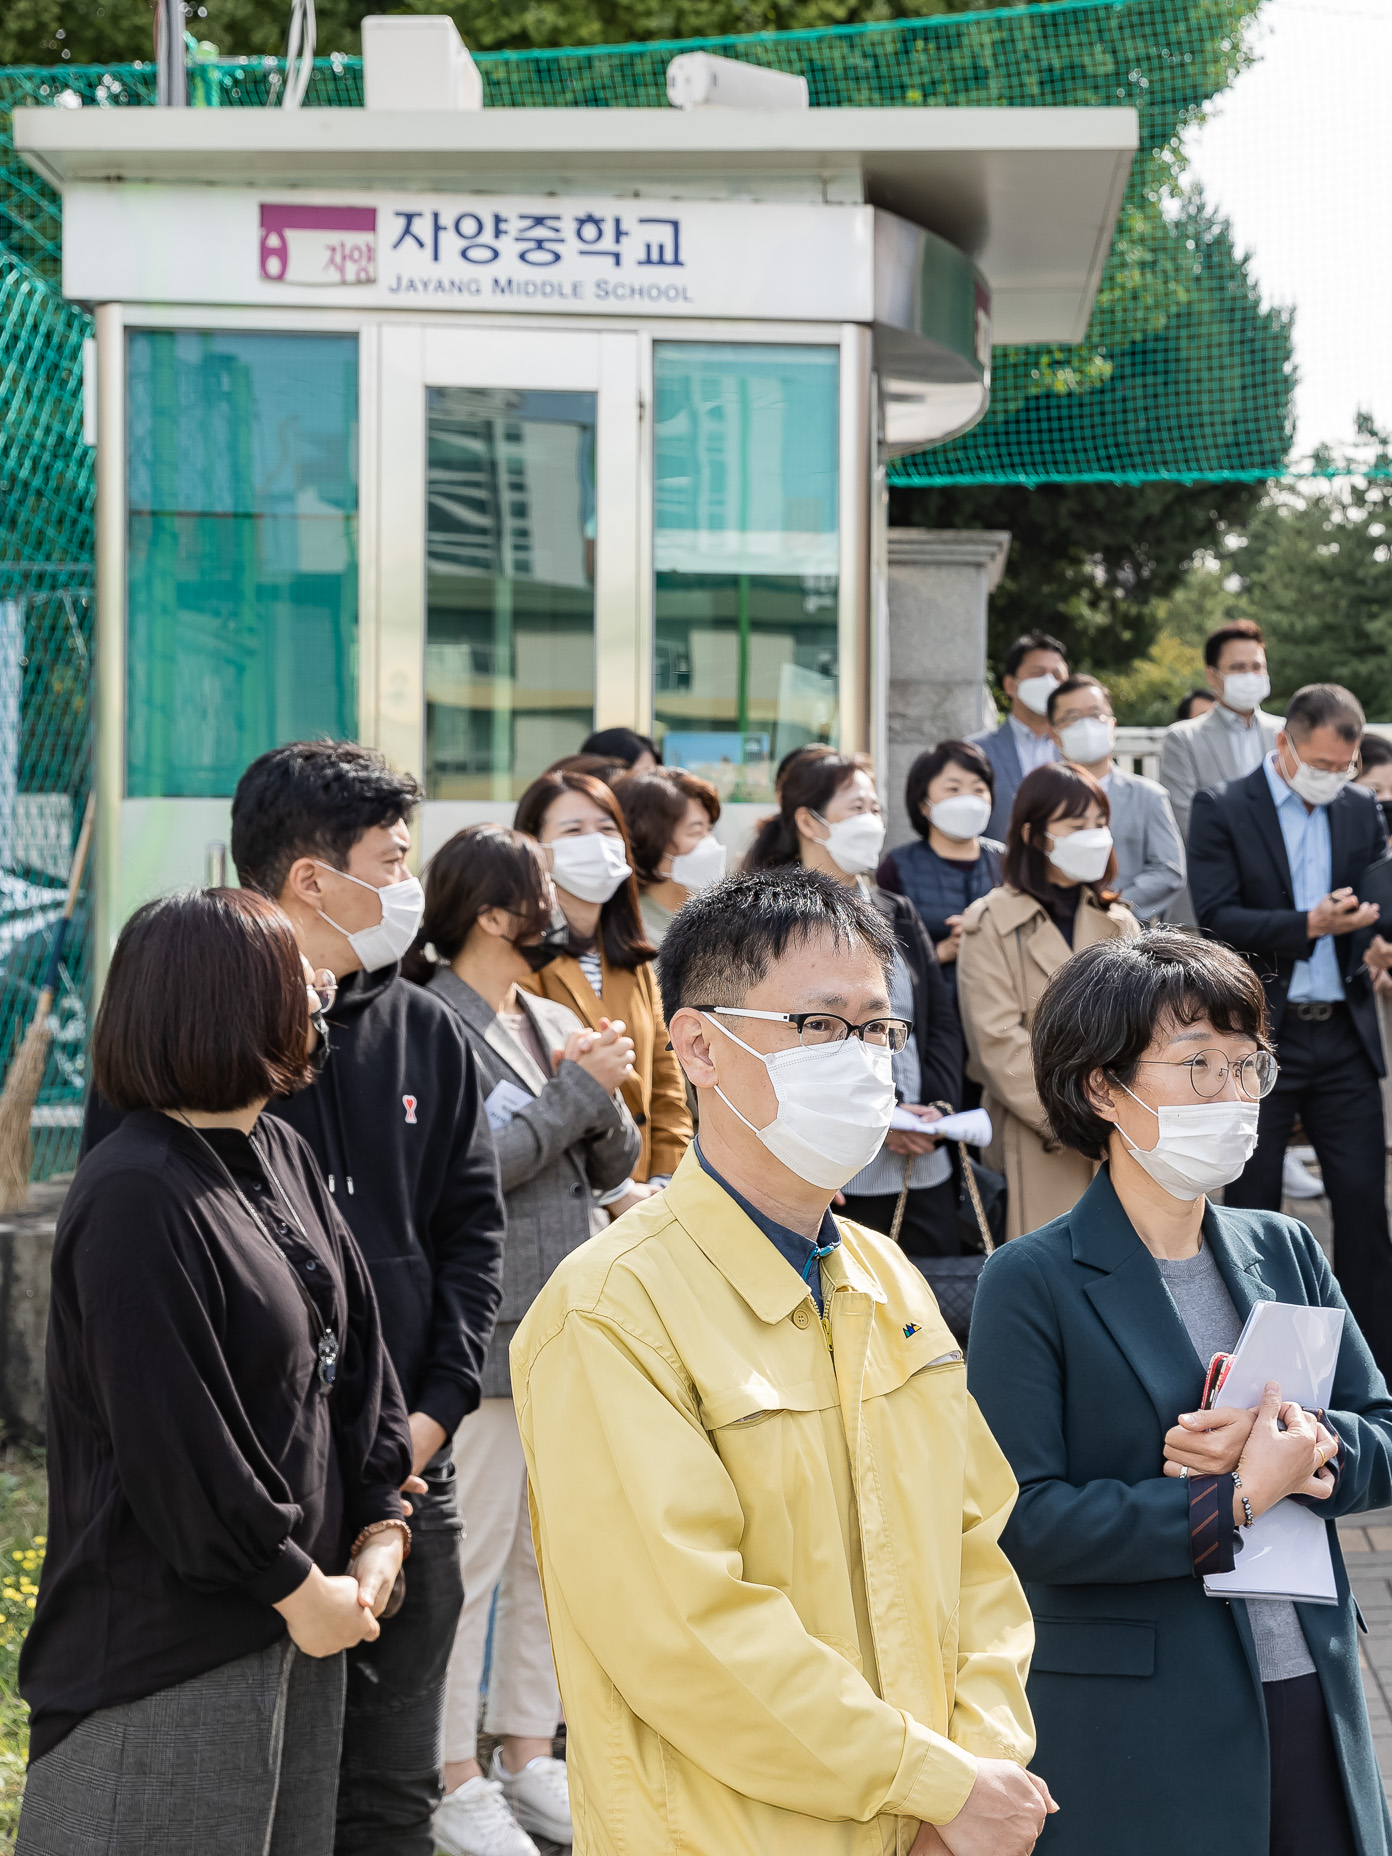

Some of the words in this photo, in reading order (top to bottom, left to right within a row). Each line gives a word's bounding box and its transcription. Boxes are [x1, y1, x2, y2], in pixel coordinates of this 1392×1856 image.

[392, 209, 685, 268] 자양중학교
[387, 275, 481, 297] JAYANG
[491, 277, 584, 300] MIDDLE
[594, 279, 694, 303] SCHOOL
